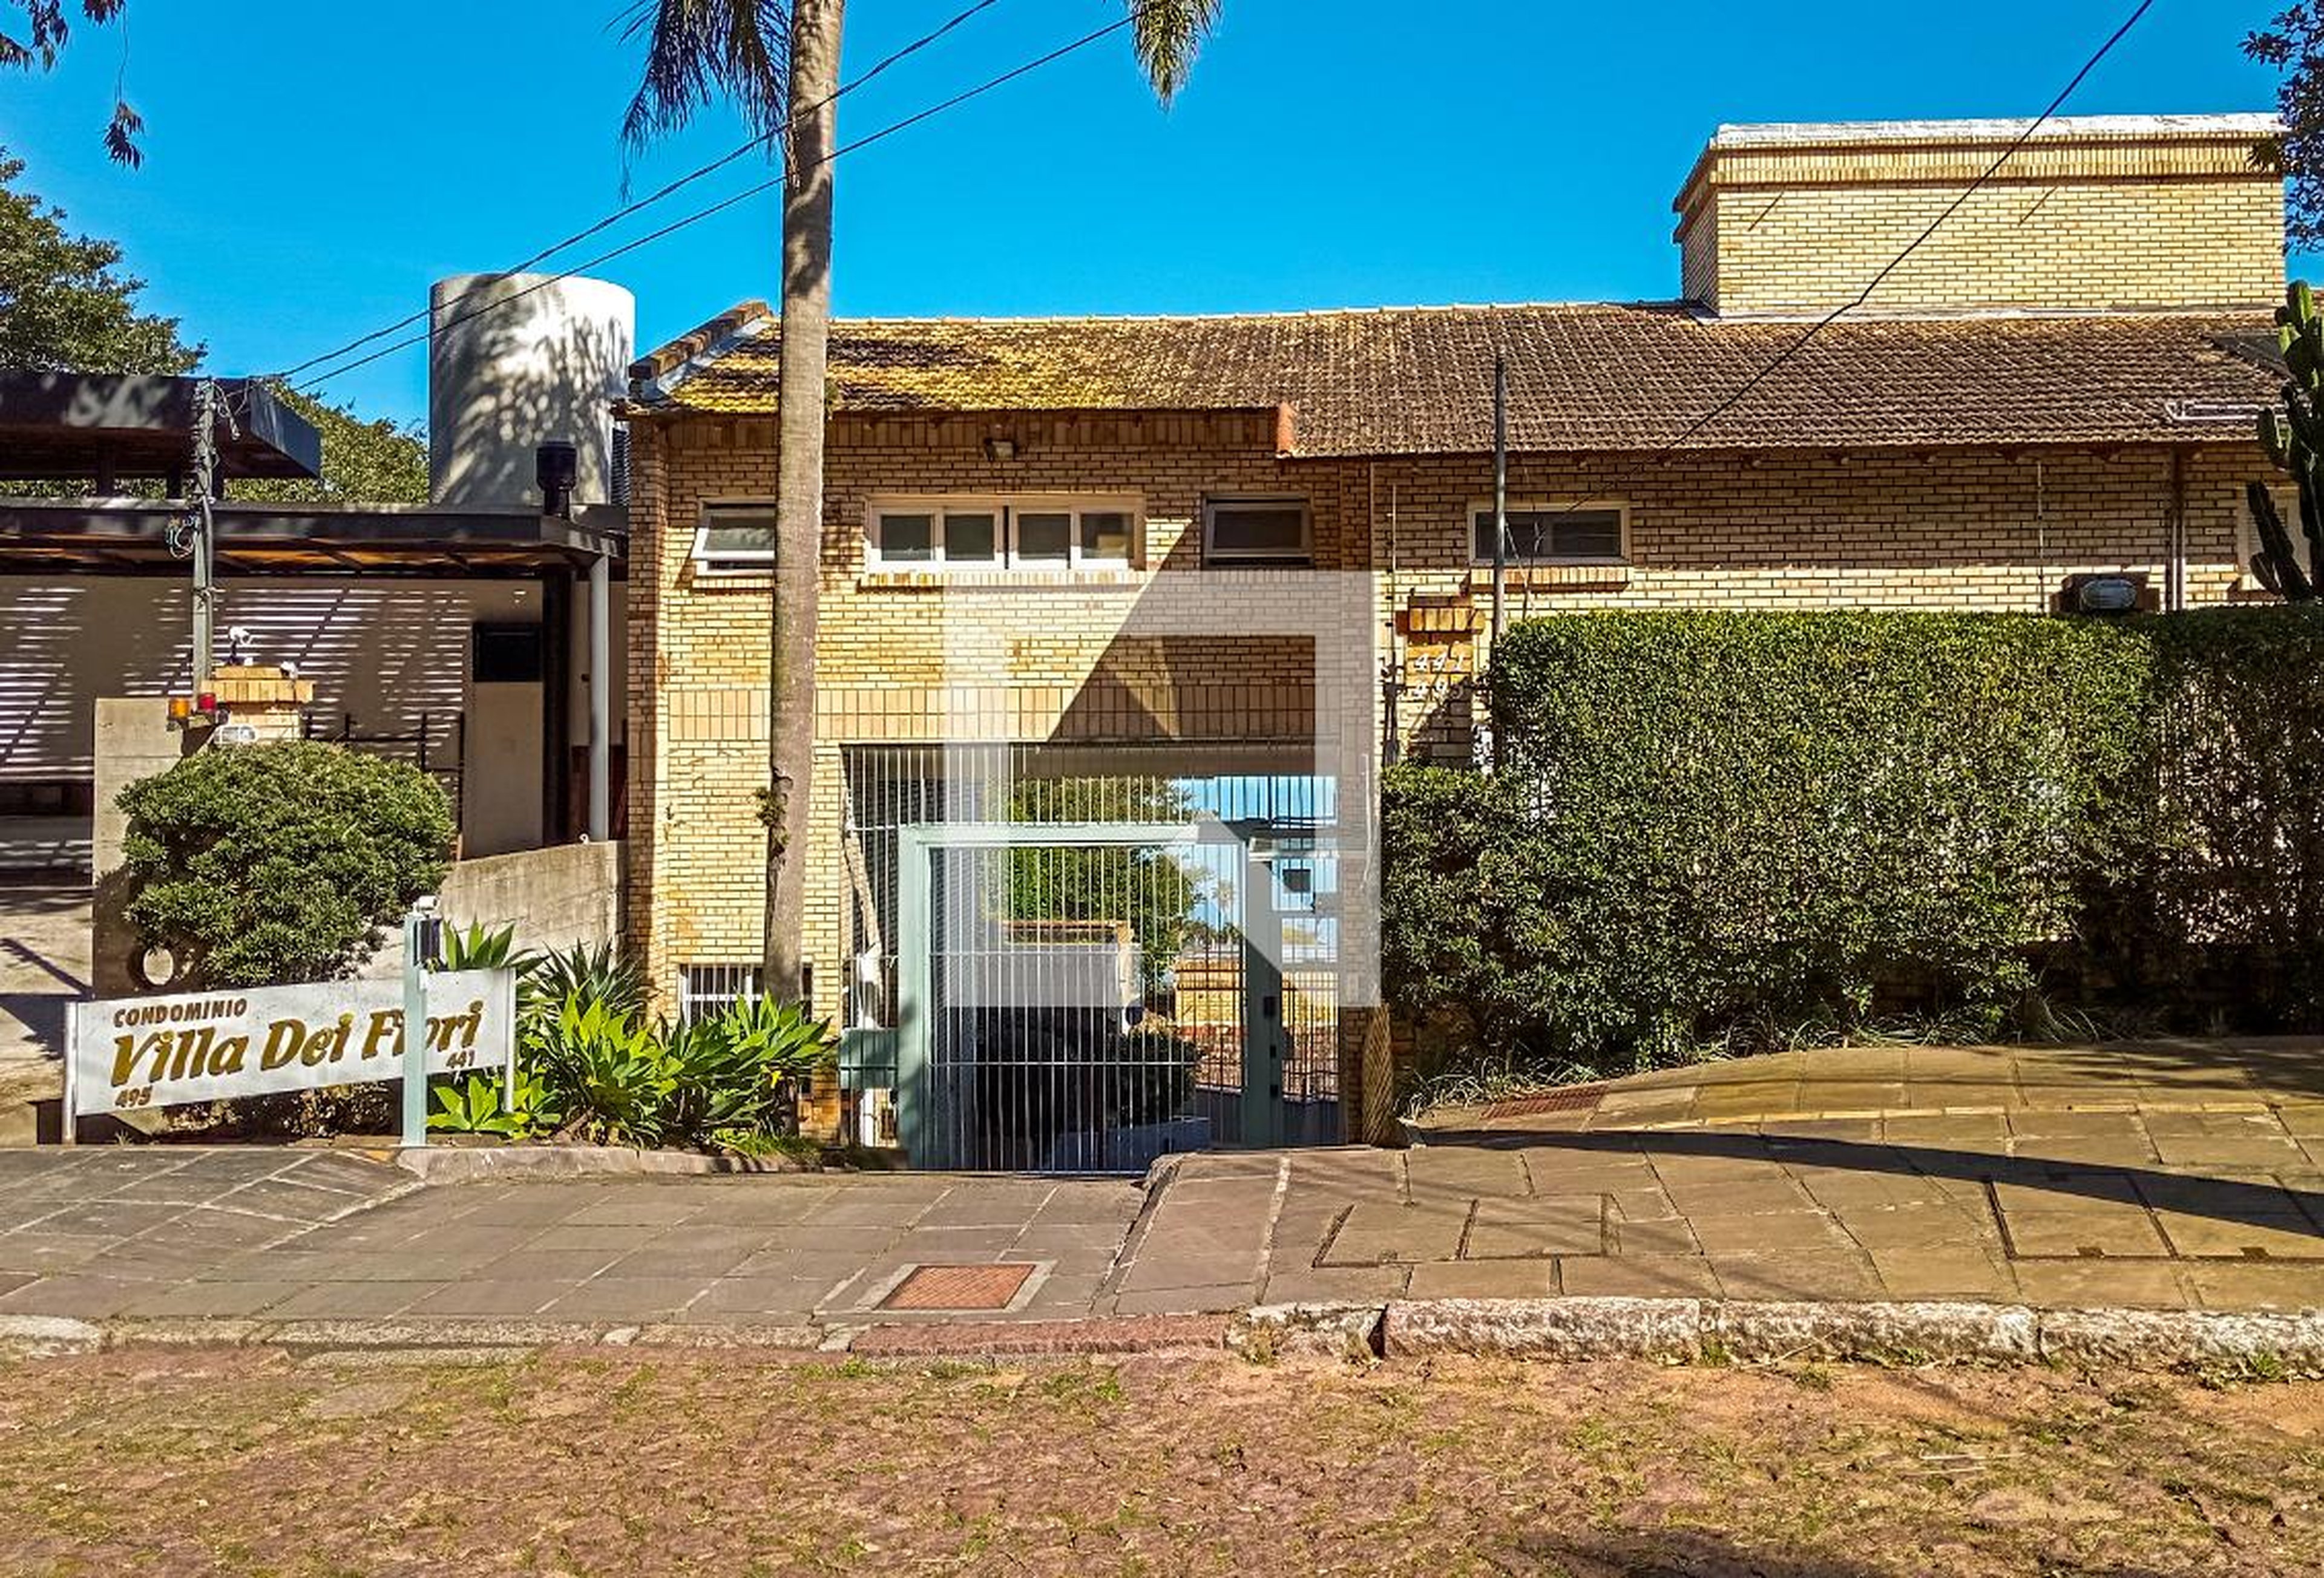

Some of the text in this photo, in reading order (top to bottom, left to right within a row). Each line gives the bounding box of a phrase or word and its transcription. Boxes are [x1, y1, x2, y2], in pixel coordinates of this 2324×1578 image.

[113, 998, 248, 1027] CONDOMINIO
[111, 1027, 249, 1087] Villa
[260, 1012, 355, 1071] Dei
[445, 1049, 476, 1069] 441
[114, 1085, 153, 1108] 495
